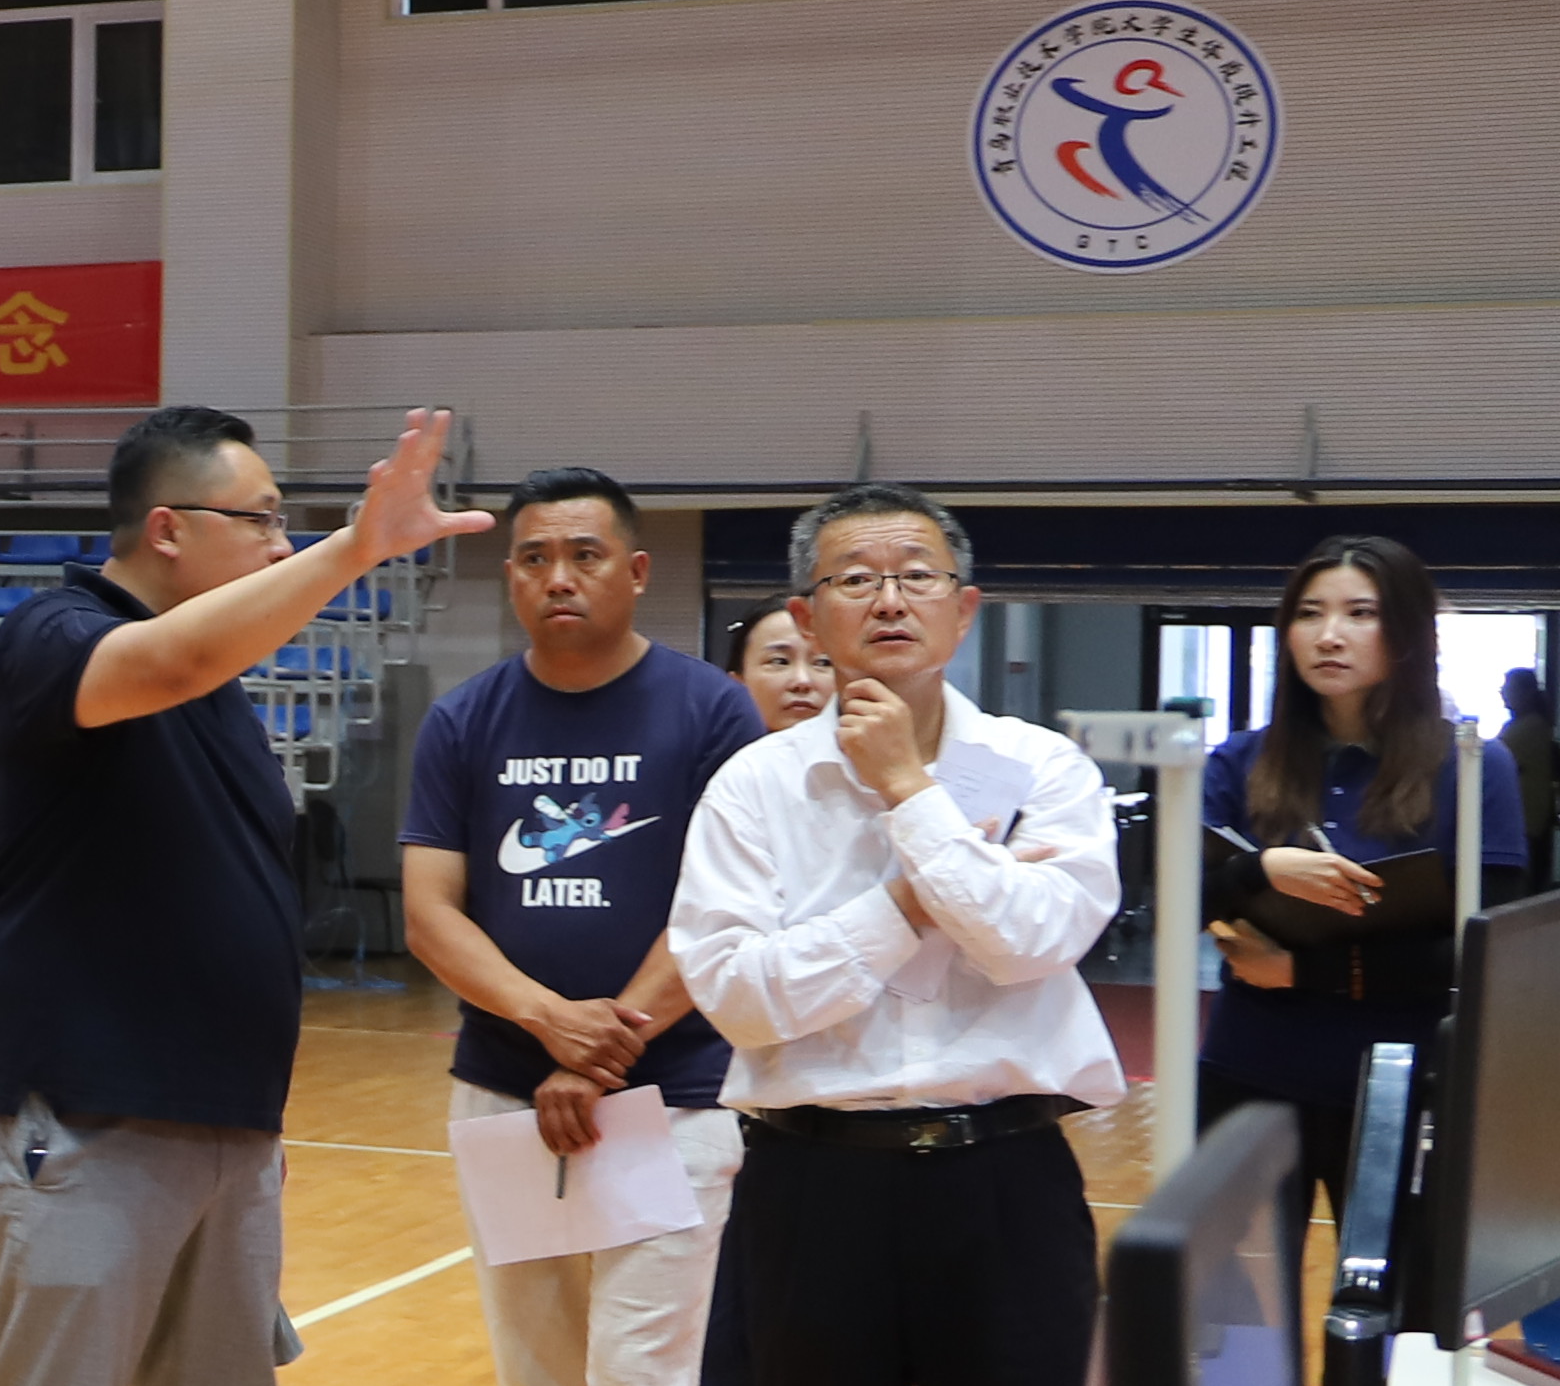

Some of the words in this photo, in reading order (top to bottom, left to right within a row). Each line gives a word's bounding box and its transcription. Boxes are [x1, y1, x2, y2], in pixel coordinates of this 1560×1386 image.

[497, 757, 568, 786] JUST
[569, 756, 610, 785] DO
[613, 755, 643, 782] IT
[521, 878, 612, 908] LATER.
